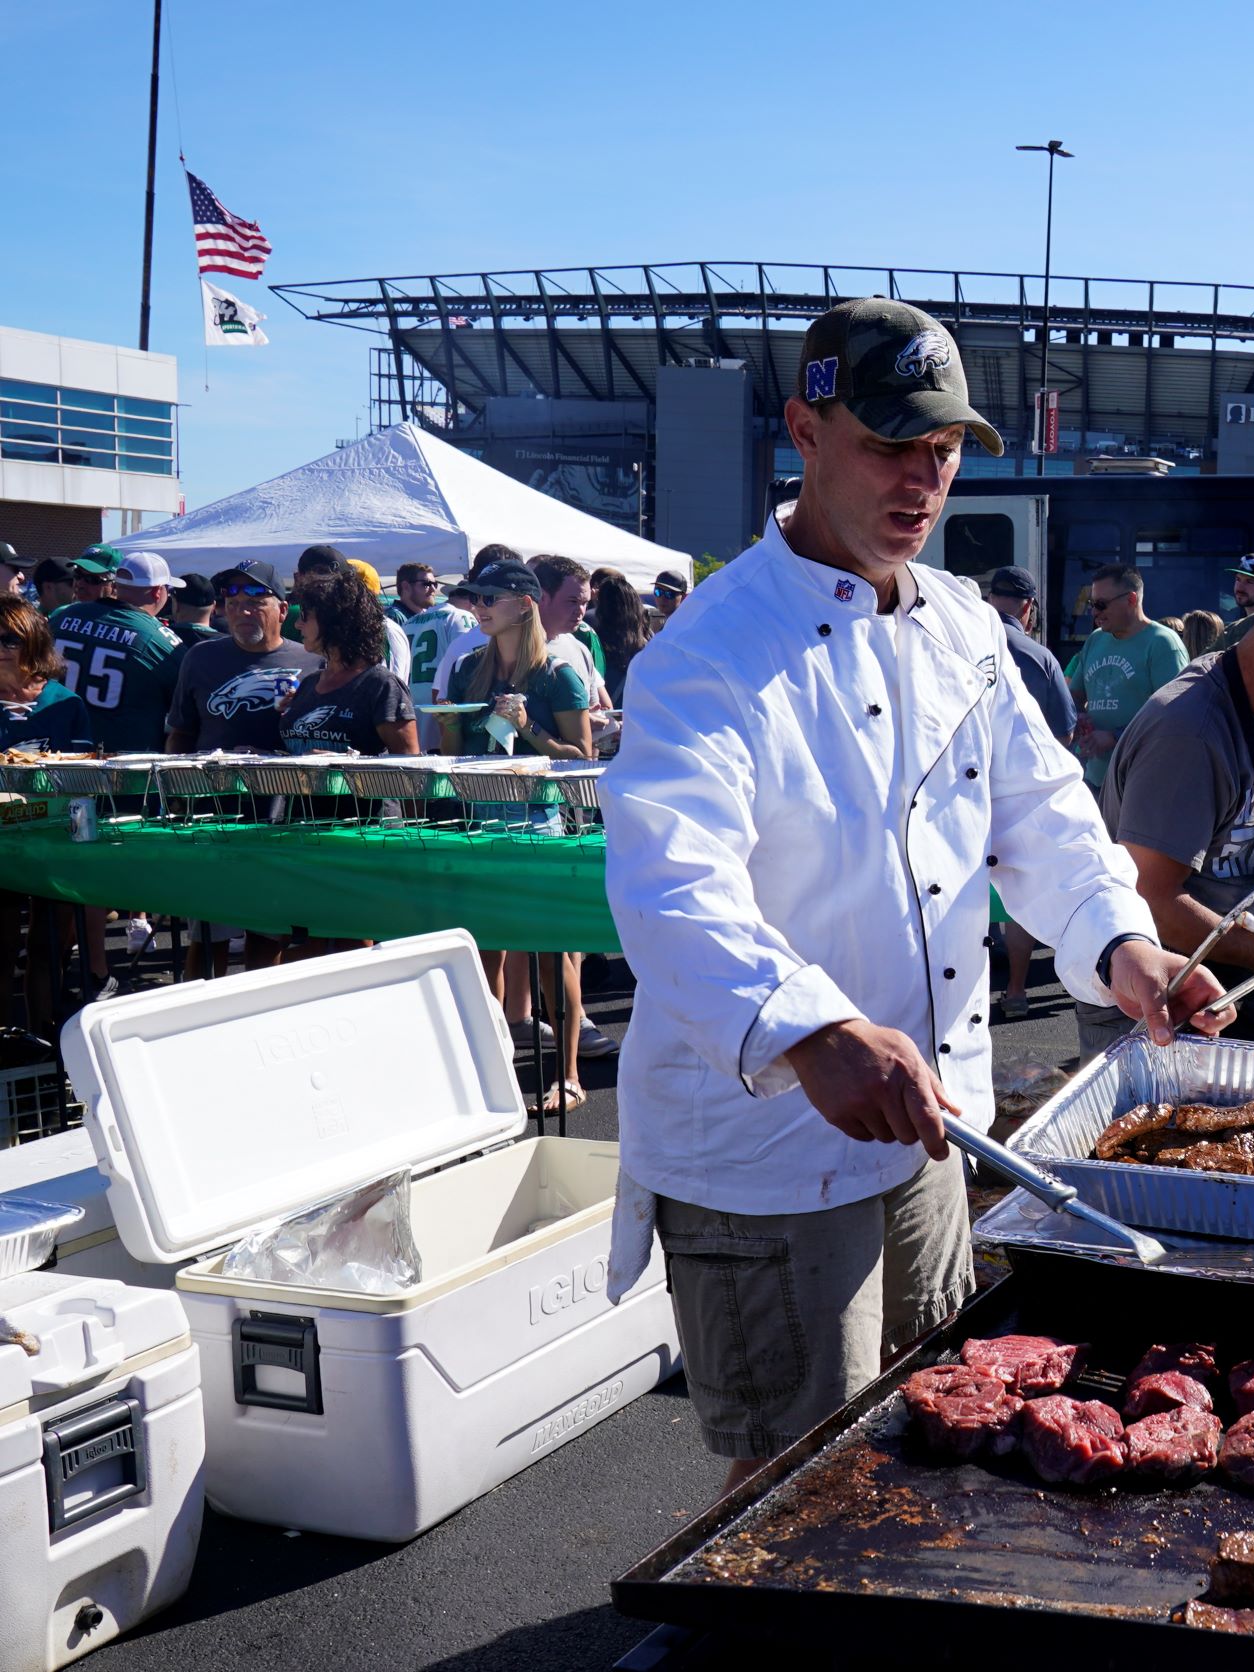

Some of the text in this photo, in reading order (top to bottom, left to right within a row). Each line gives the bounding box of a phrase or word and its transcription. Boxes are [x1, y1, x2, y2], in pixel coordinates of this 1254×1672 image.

[526, 451, 610, 463] Lincoln Financial Field
[60, 617, 138, 646] GRAHAM
[54, 638, 126, 709] 55
[1084, 655, 1136, 681] PHILADELPHIA
[1089, 699, 1119, 711] EAGLES
[279, 729, 310, 738] SUPER
[313, 730, 352, 742] BOWL
[529, 1254, 610, 1326] IGLO
[530, 1379, 625, 1454] MAXCOLD
[85, 1443, 107, 1460] igloo
